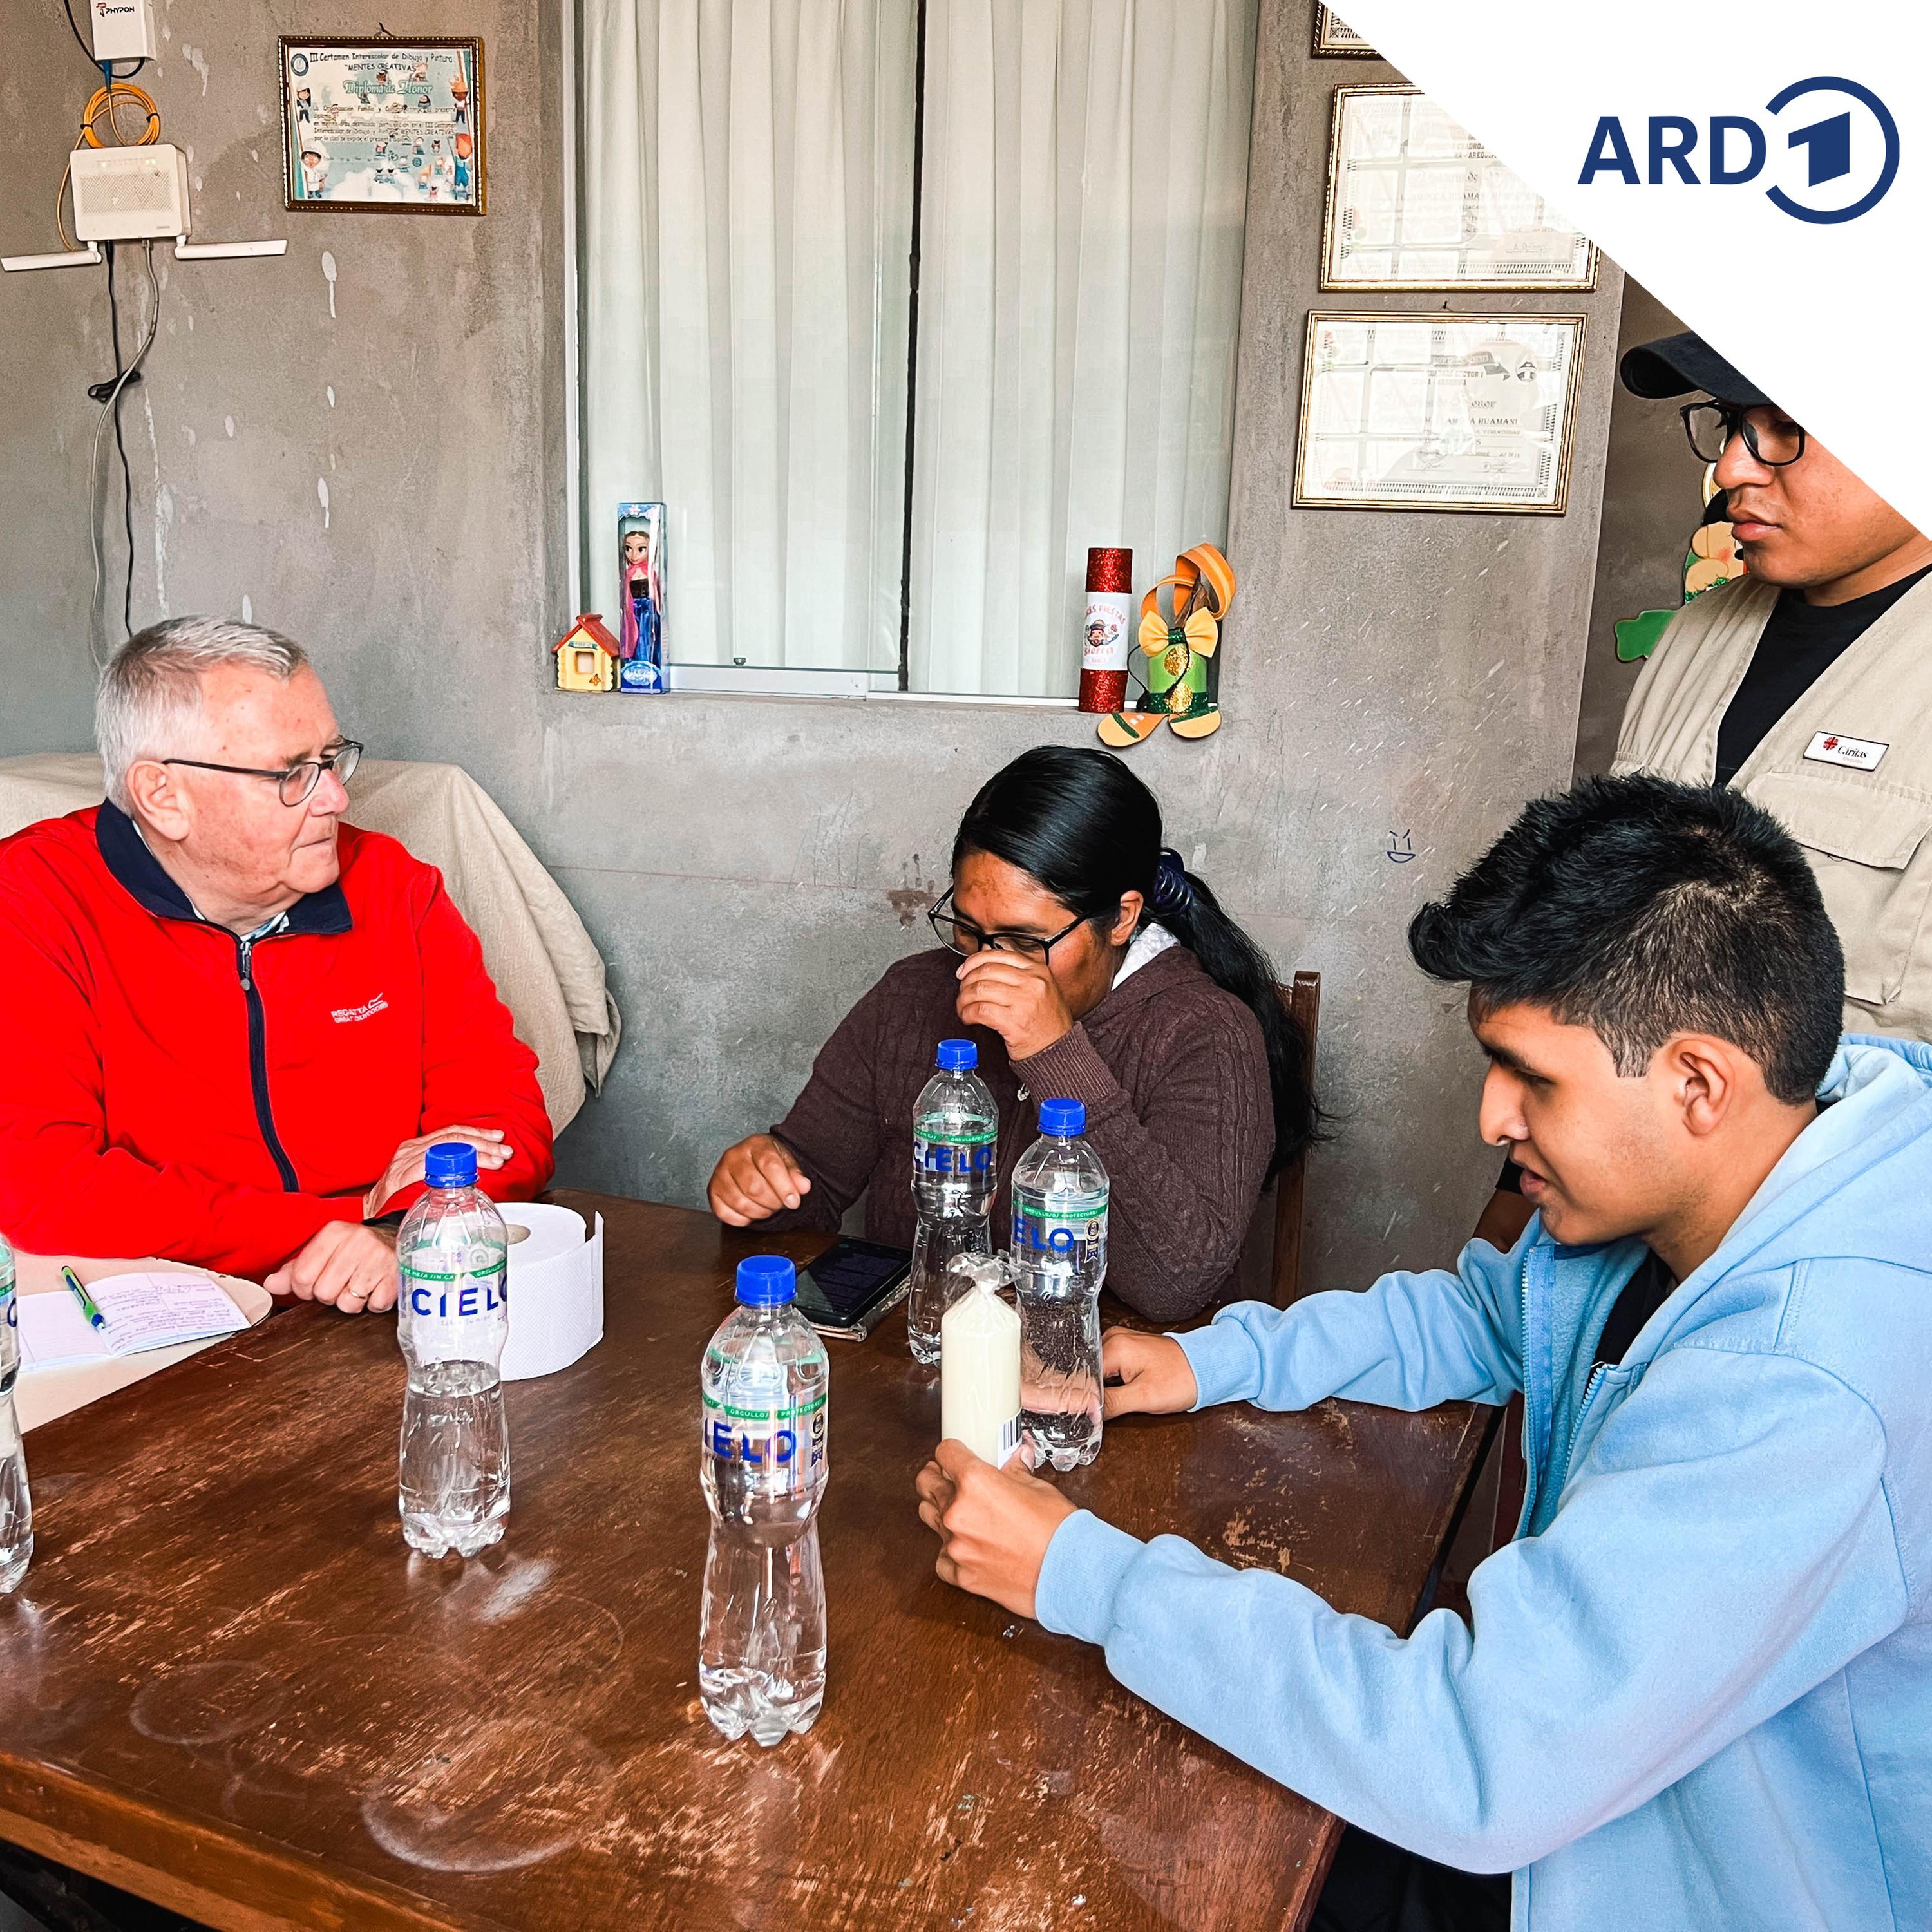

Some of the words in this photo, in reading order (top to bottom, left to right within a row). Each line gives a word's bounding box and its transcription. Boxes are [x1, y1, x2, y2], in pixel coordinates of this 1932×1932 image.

[310, 52, 318, 62] III
[319, 53, 350, 61] Certamen
[402, 53, 422, 62] Dibujo
[343, 79, 384, 99] Diploma
[384, 79, 395, 94] de
[1837, 745, 1868, 759] Caritas
[330, 1005, 368, 1018] REGATTA
